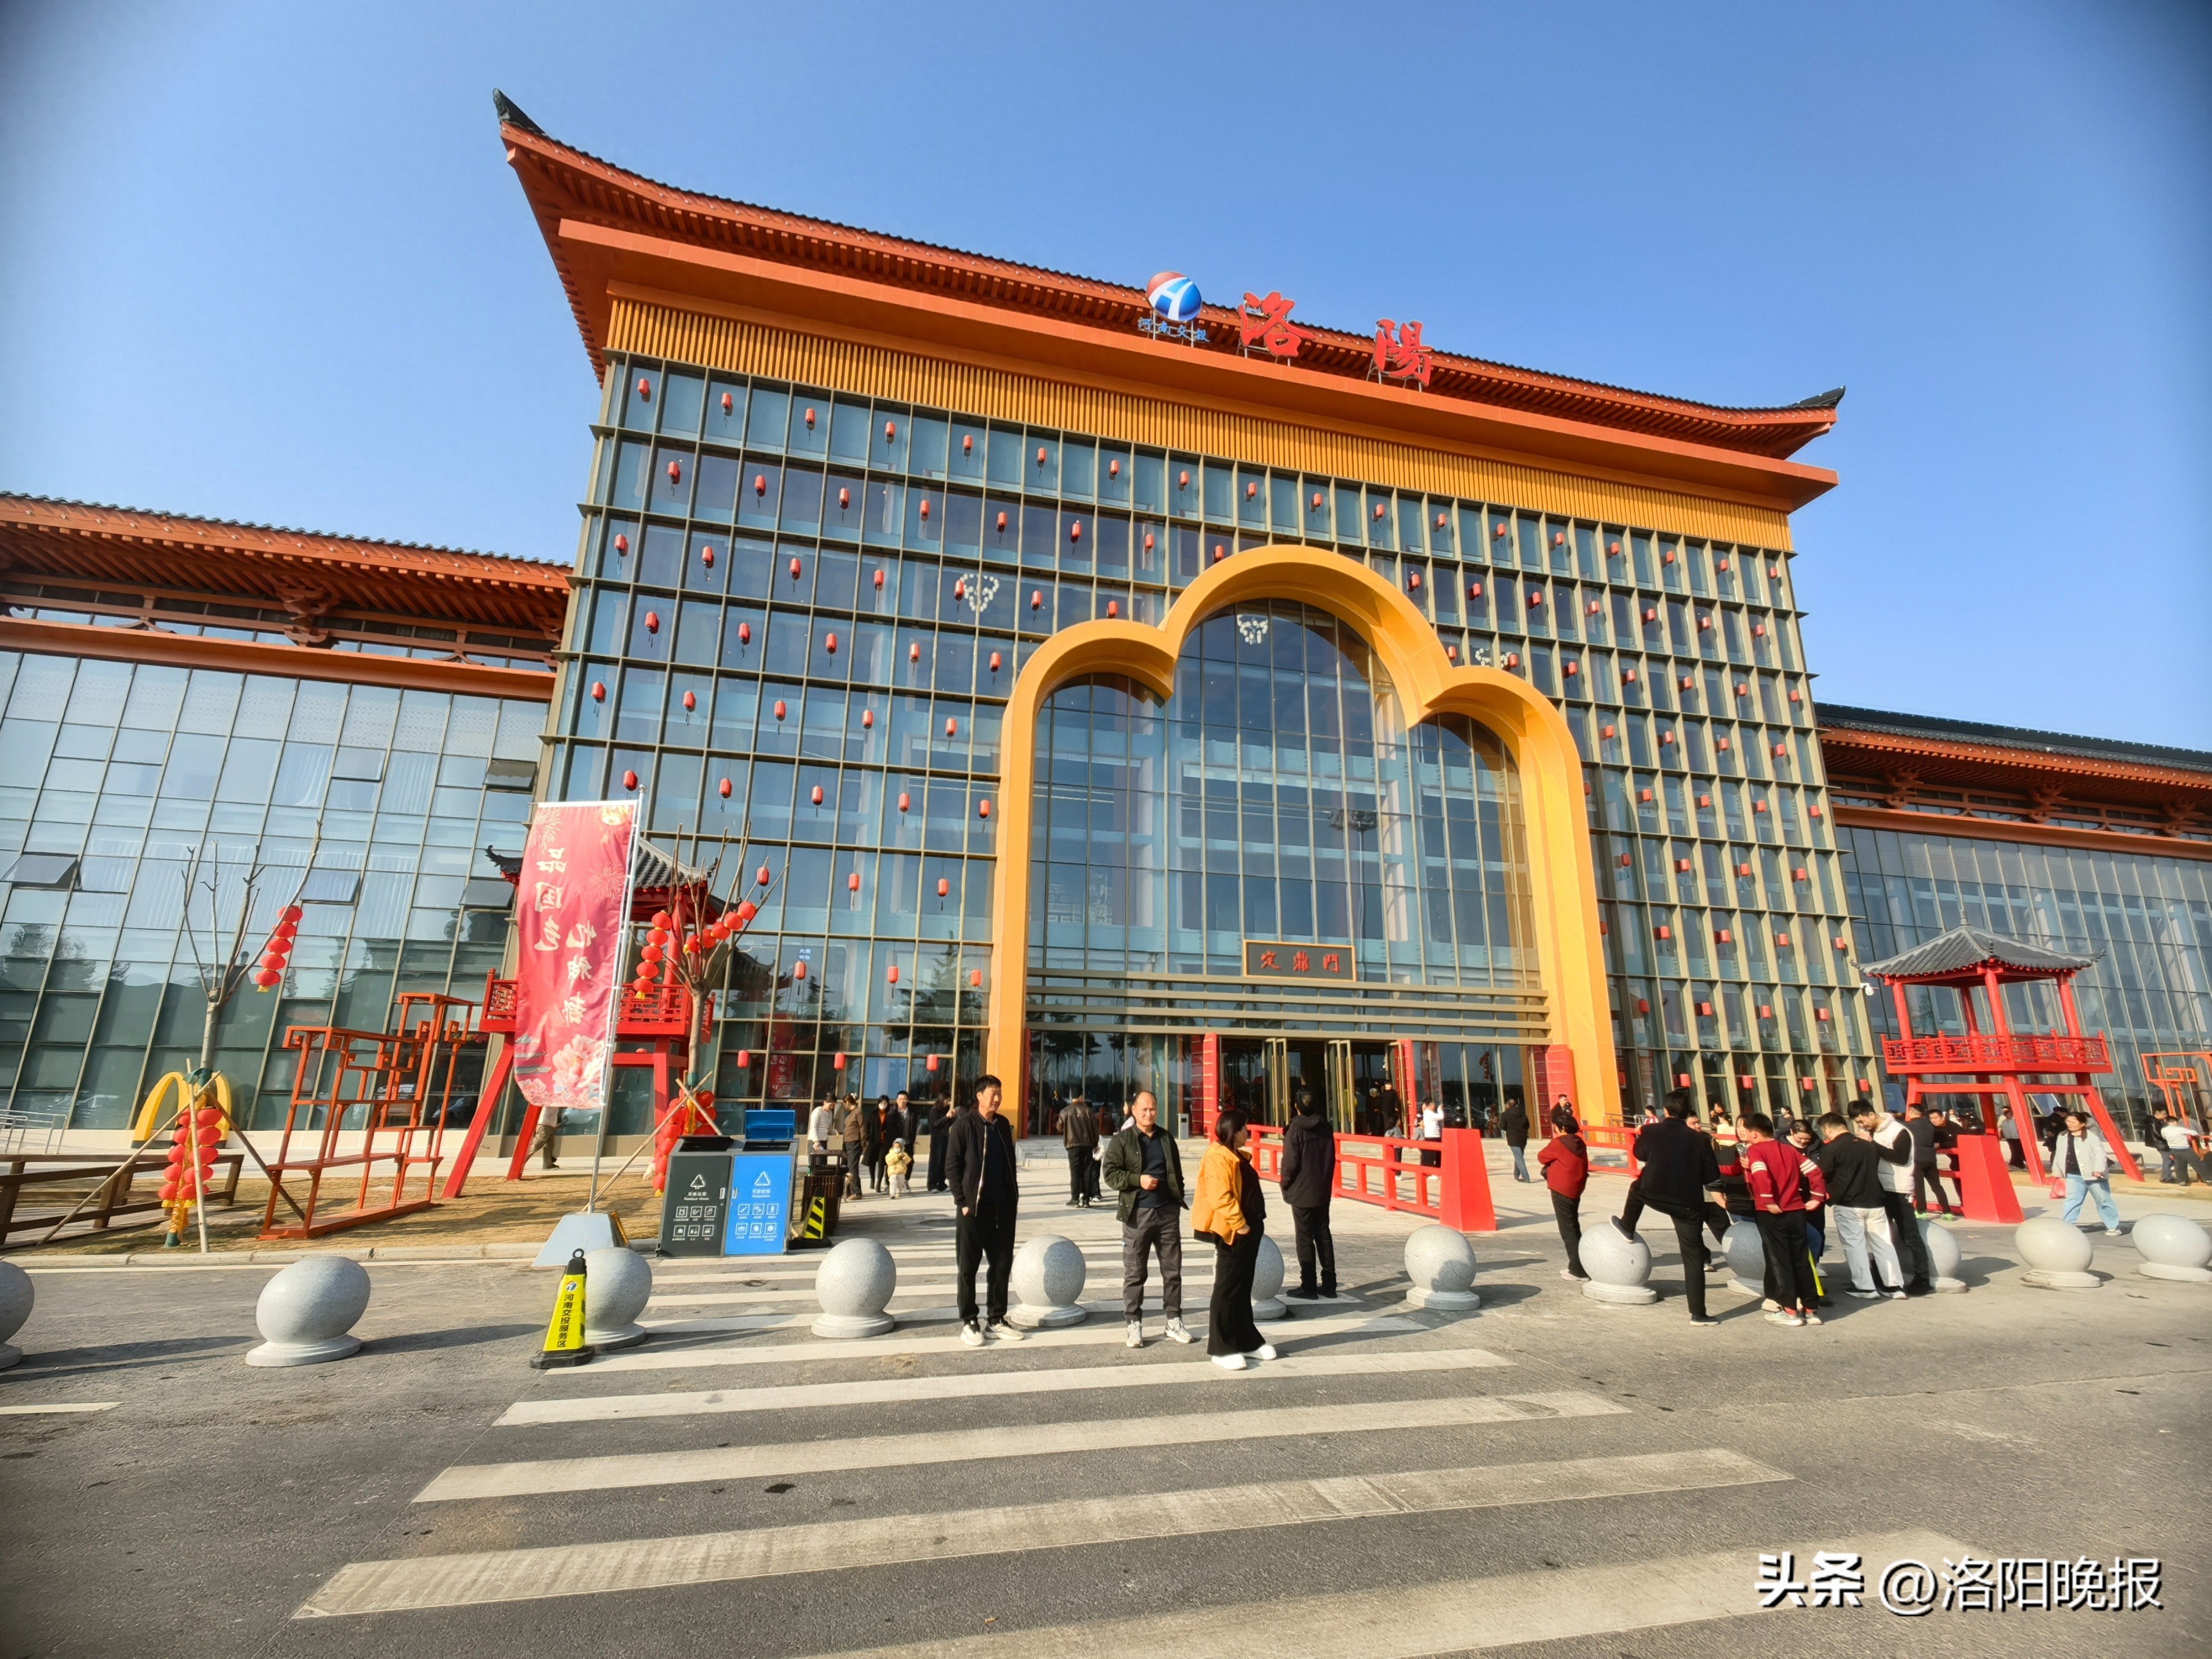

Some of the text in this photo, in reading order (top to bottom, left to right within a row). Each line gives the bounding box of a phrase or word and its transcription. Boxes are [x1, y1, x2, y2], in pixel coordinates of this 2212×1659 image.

[1260, 950, 1340, 974] 定鼎門
[557, 1293, 574, 1348] 河南交投服务区
